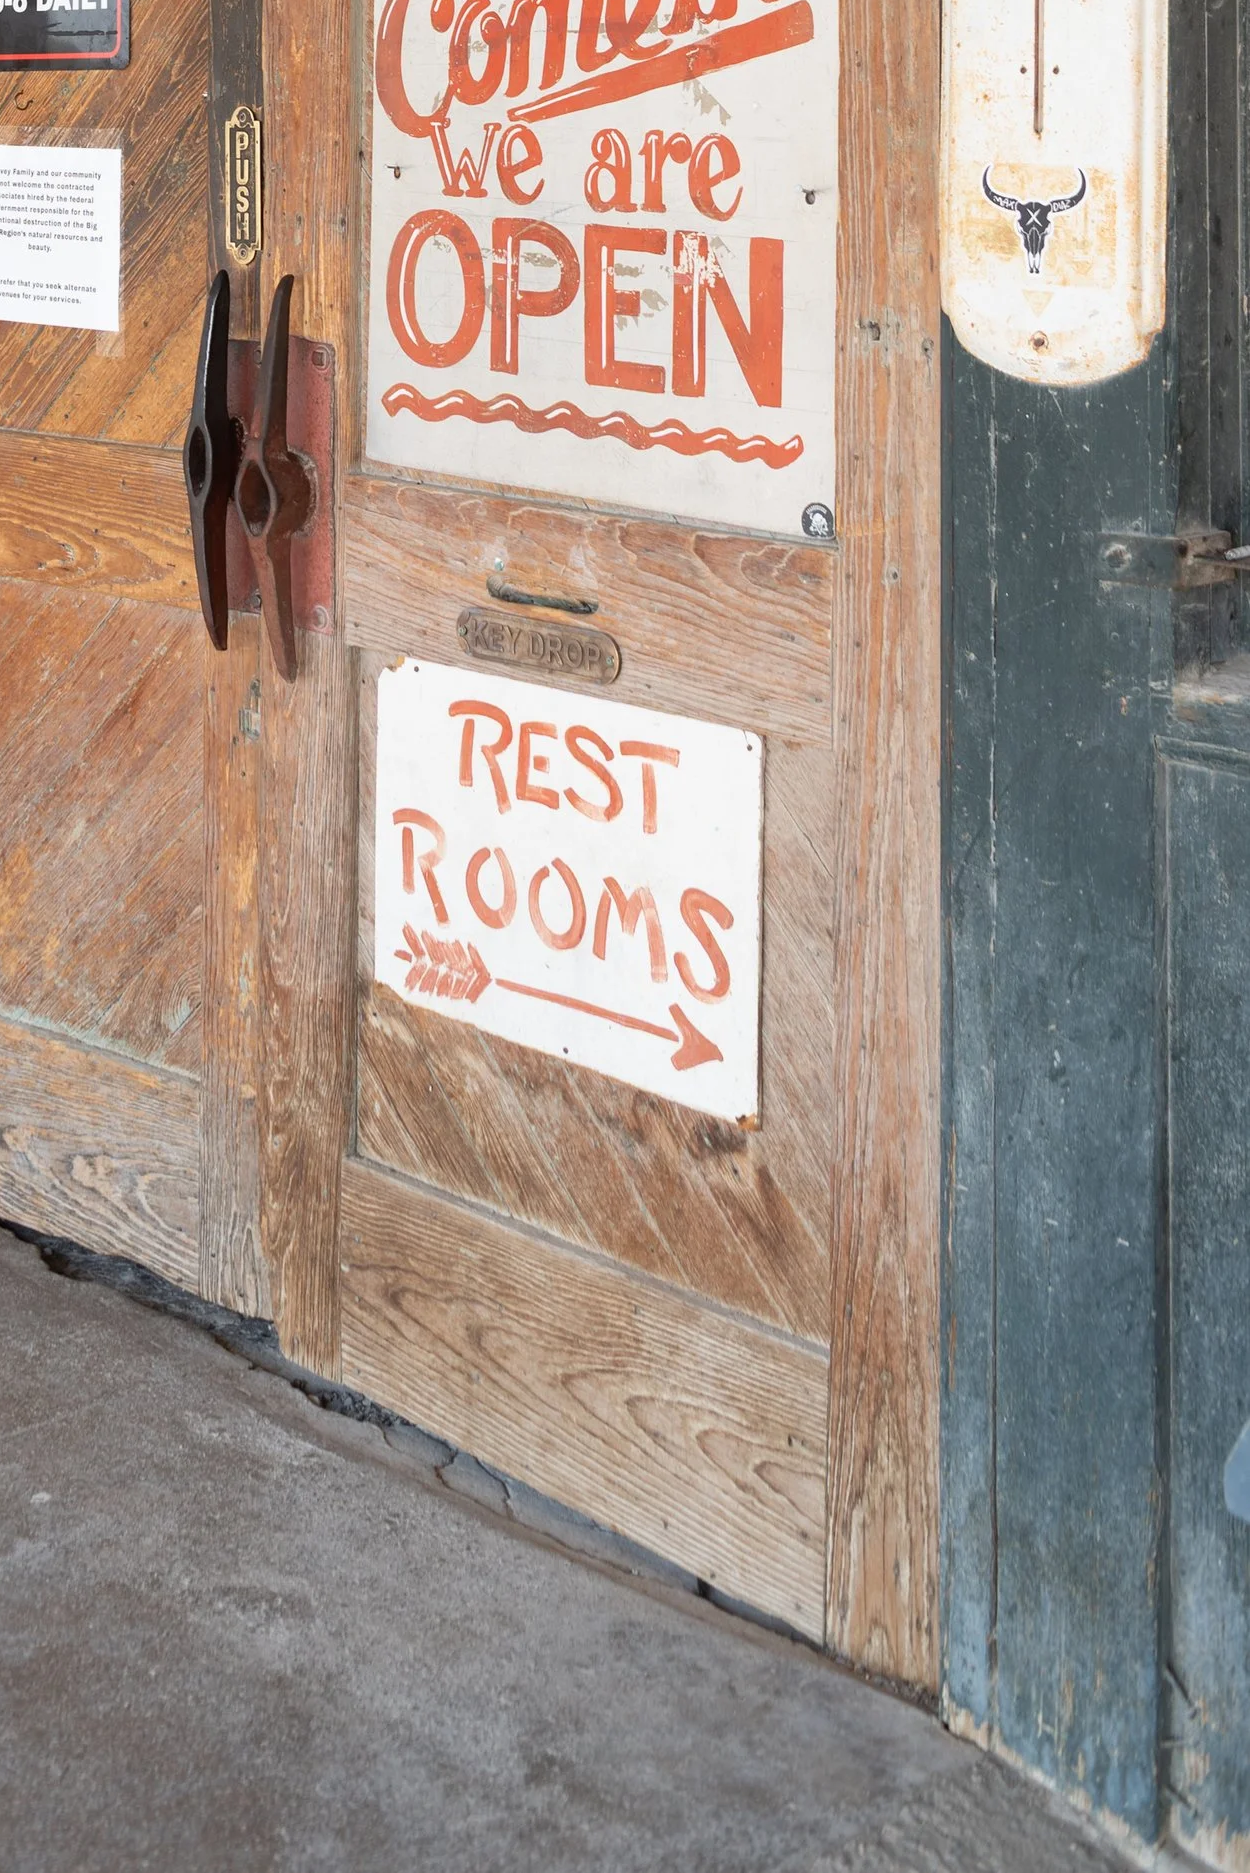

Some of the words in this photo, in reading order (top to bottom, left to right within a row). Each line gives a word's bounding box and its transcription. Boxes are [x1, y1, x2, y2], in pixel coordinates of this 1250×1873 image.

[13, 168, 35, 177] Family
[36, 169, 49, 177] and
[64, 171, 102, 180] community
[584, 127, 743, 222] are
[12, 180, 42, 189] welcome
[56, 182, 95, 191] contracted
[235, 131, 250, 240] PUSH
[27, 193, 45, 201] hired
[46, 194, 55, 202] by
[69, 195, 94, 204] federal
[30, 206, 69, 216] responsible
[71, 208, 81, 216] for
[82, 209, 94, 217] the
[1052, 199, 1071, 212] DIAZ
[22, 218, 62, 227] destruction
[63, 220, 71, 228] of
[72, 220, 84, 229] the
[86, 222, 98, 231] Big
[28, 231, 52, 239] natural
[53, 233, 88, 242] resources
[90, 235, 103, 243] and
[17, 279, 31, 287] that
[32, 281, 44, 290] you
[45, 282, 62, 290] seek
[64, 284, 97, 293] alternate
[33, 294, 48, 303] your
[385, 209, 785, 409] OPEN
[469, 618, 521, 656] KEY
[529, 630, 603, 671] DROP
[449, 700, 681, 834] REST
[392, 808, 735, 1004] ROOMS
